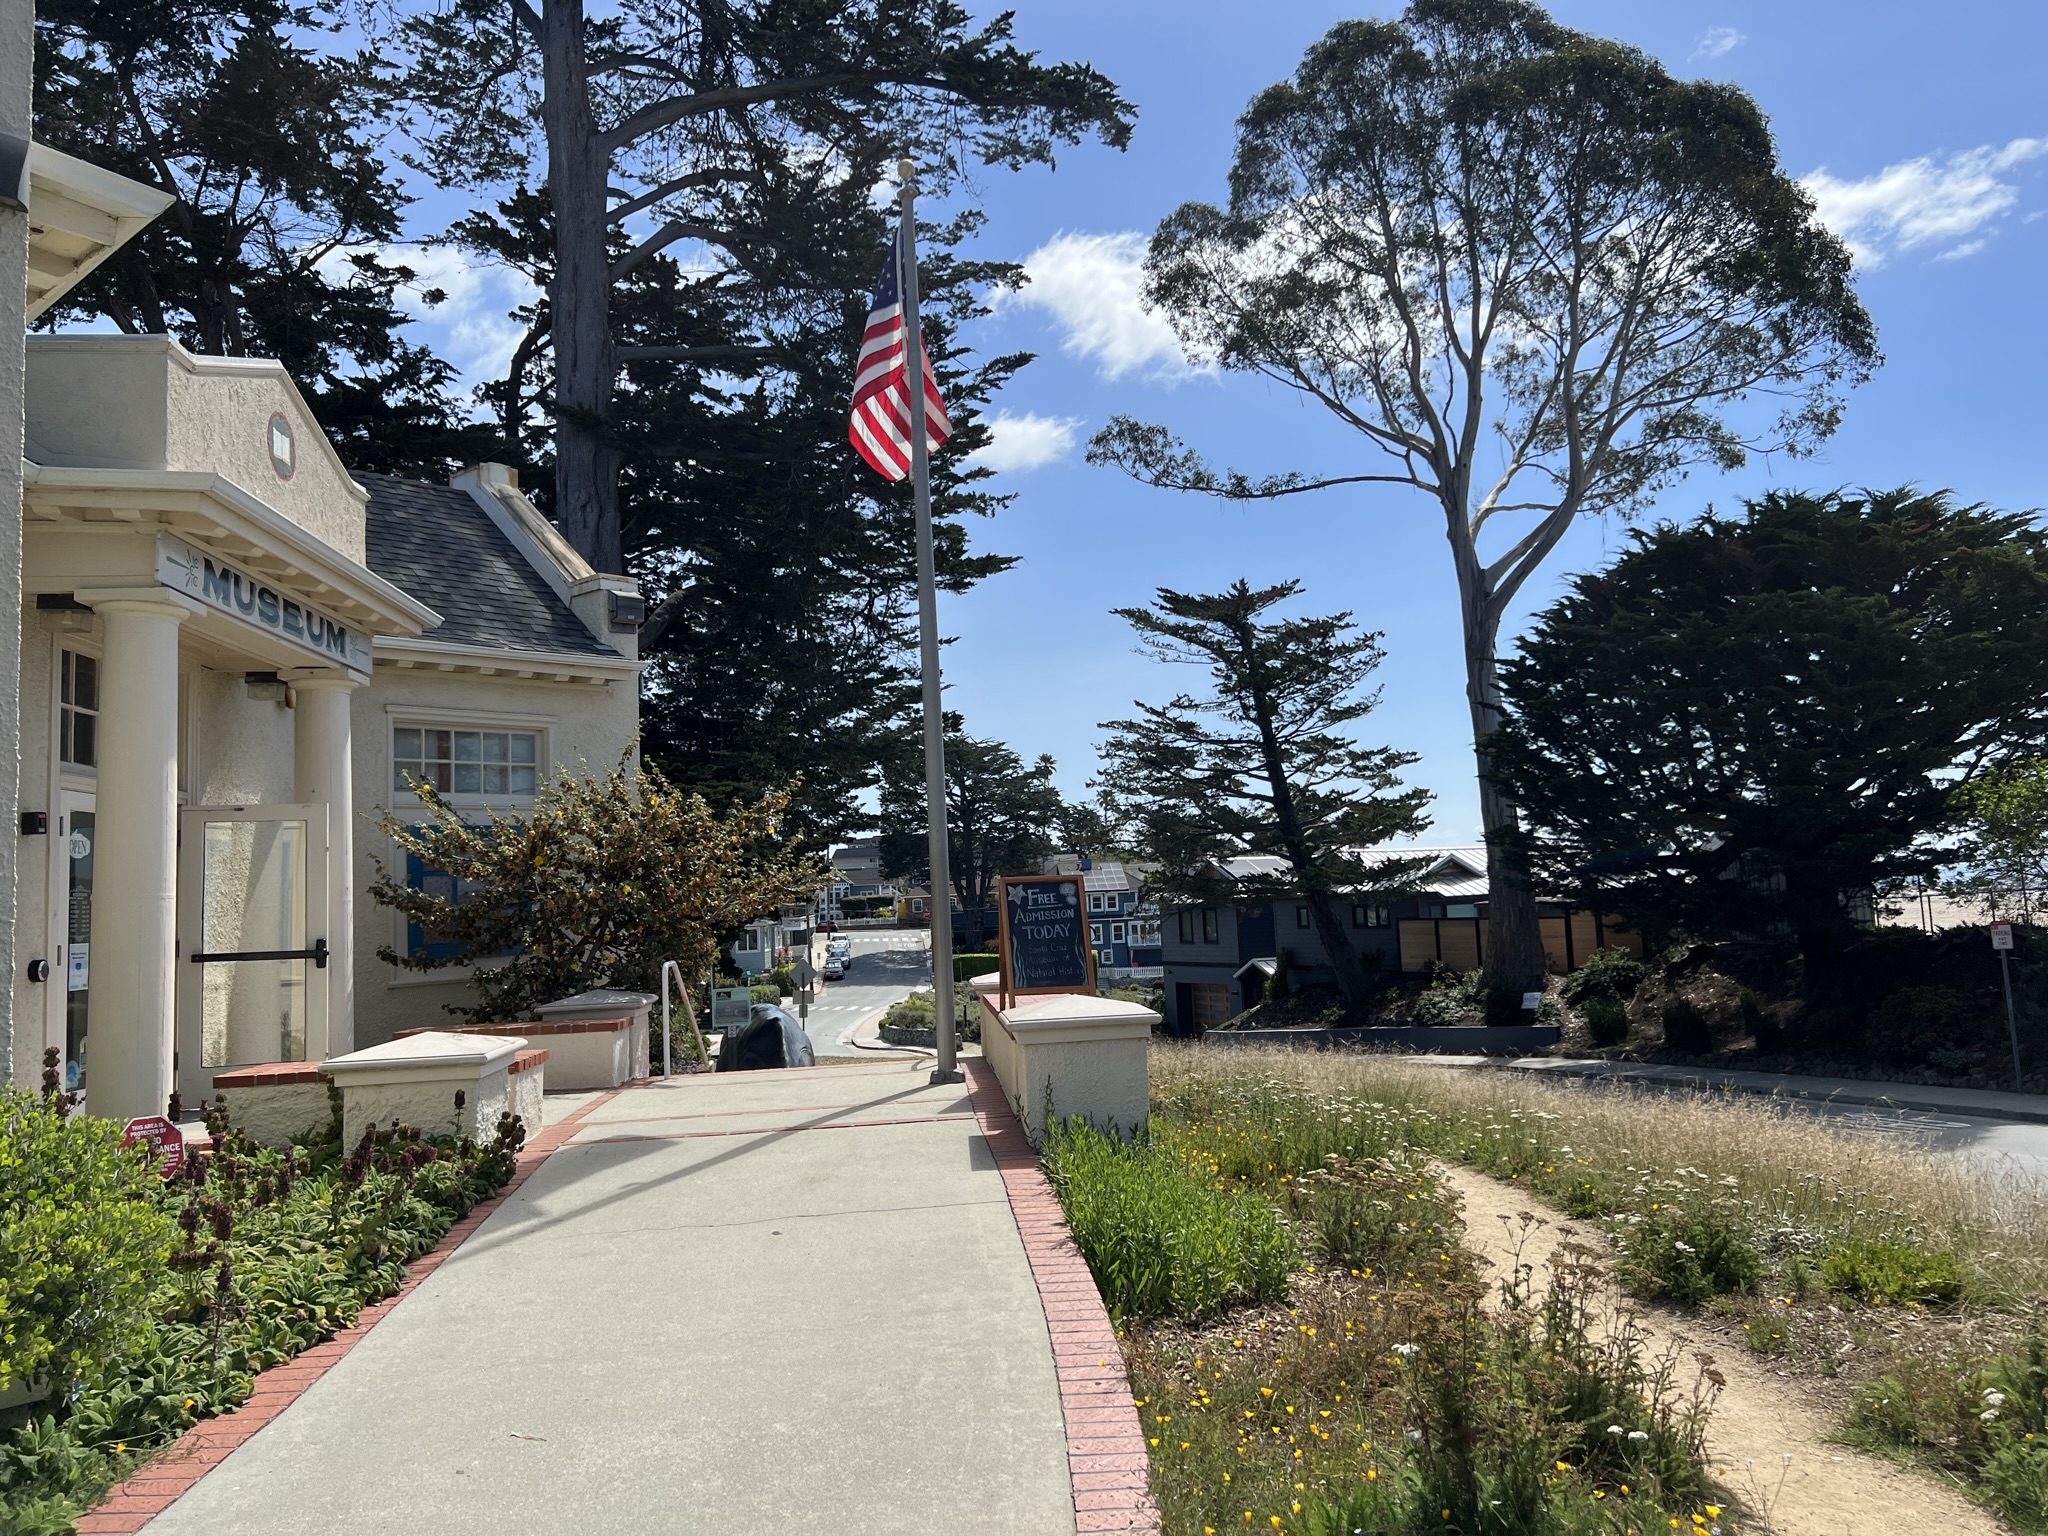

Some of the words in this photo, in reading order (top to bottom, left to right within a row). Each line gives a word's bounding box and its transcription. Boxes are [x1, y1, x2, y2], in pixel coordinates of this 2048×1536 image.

[202, 557, 347, 660] MUSEUM
[70, 839, 87, 855] OPEN
[1027, 889, 1058, 905] FREE
[1014, 908, 1075, 923] ADMISSION
[1022, 923, 1071, 940] TODAY
[1050, 943, 1068, 952] Cruz
